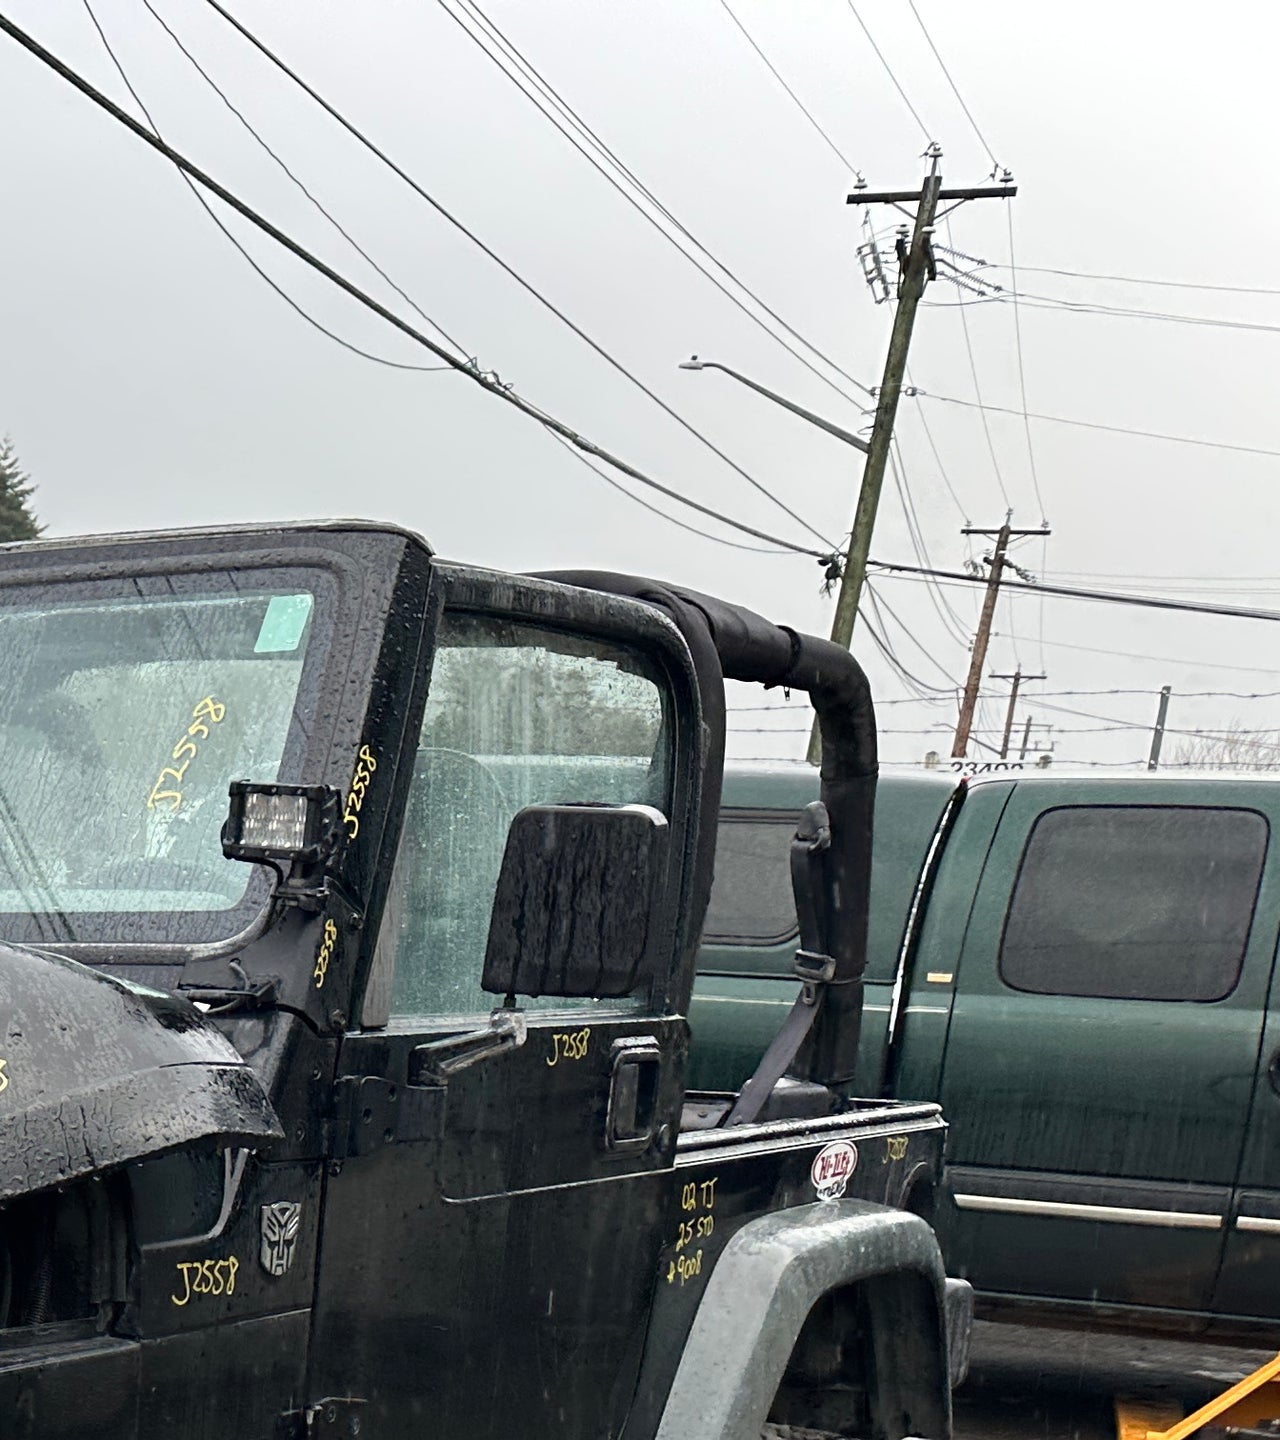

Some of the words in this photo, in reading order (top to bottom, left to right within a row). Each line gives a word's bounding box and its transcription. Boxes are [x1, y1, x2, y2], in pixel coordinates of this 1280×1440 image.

[146, 694, 226, 810] J2558
[343, 744, 377, 840] J2558
[171, 1255, 239, 1306] J2558
